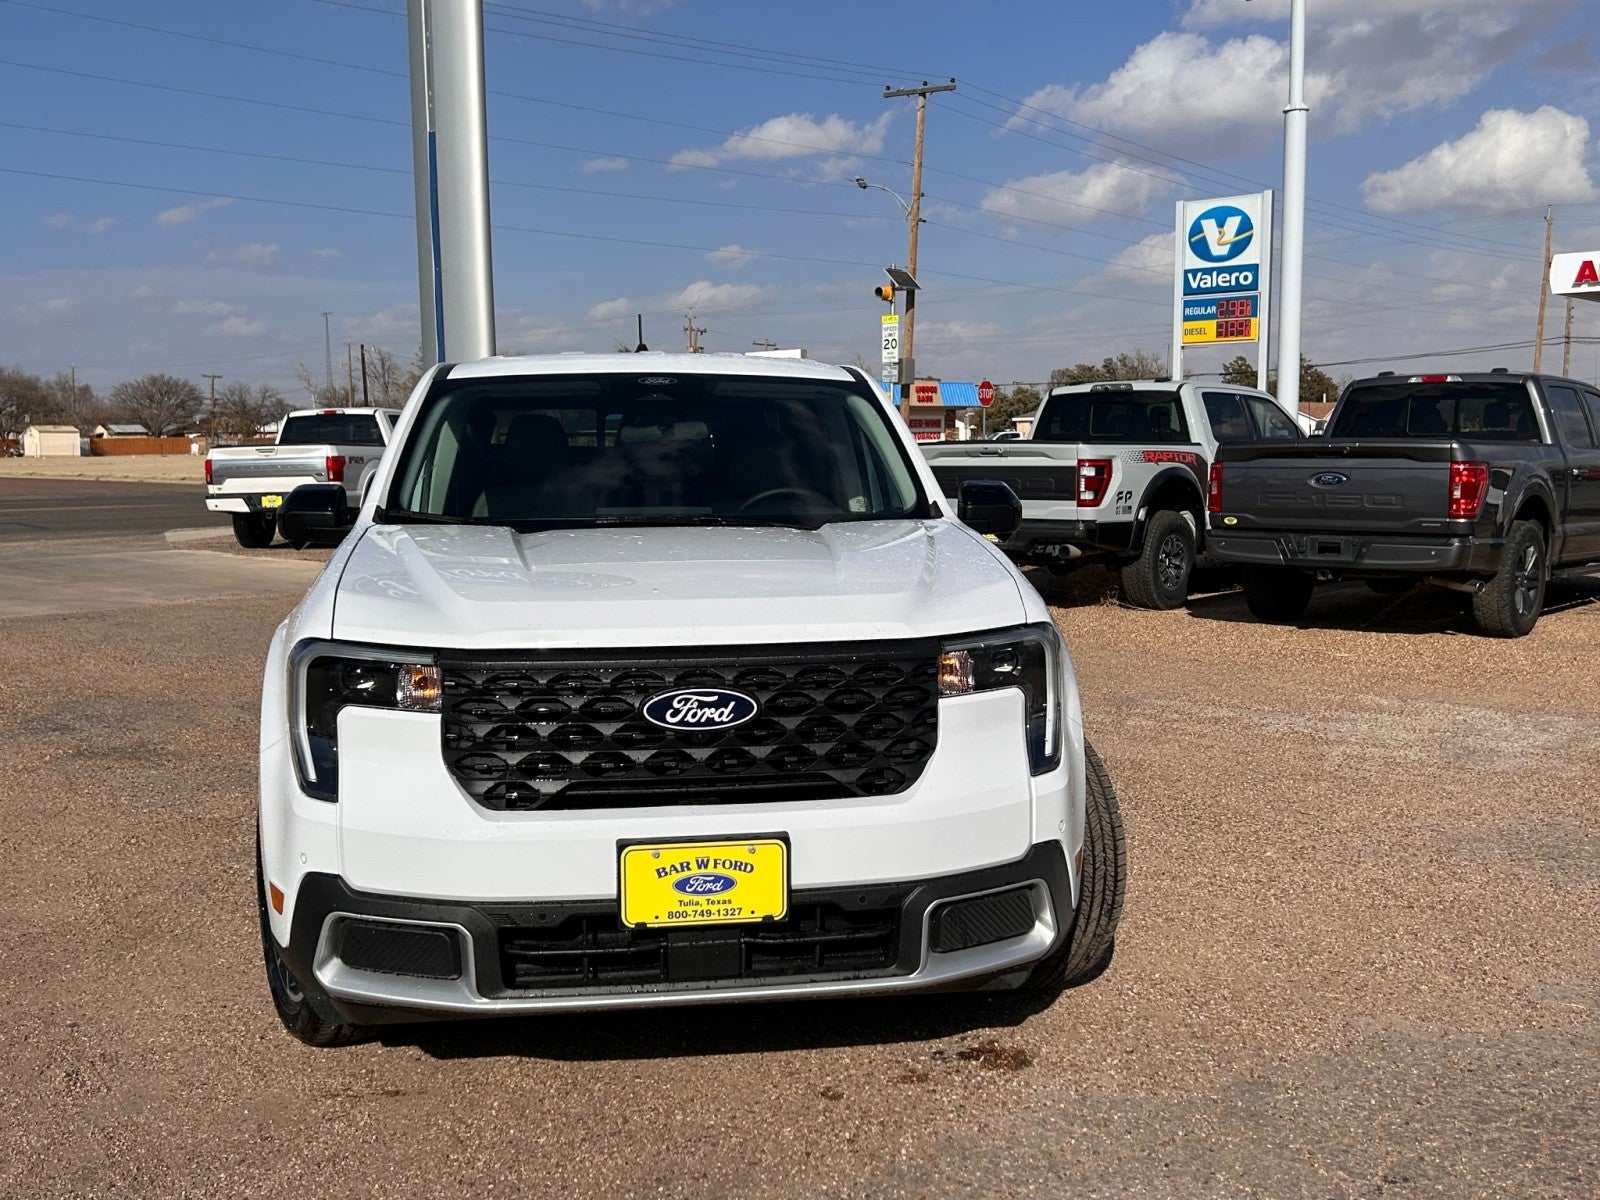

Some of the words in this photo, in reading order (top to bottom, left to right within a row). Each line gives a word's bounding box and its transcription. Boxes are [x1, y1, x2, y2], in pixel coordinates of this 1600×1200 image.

[1187, 271, 1253, 289] Valero
[1184, 306, 1217, 316] REGULAR
[1184, 326, 1208, 336] DIESEL
[883, 338, 898, 350] 20
[979, 388, 993, 399] STOP
[913, 432, 941, 440] TOBACCO
[1143, 450, 1197, 465] RAPTOR
[1257, 491, 1405, 509] F-150
[665, 694, 736, 724] Ford
[655, 860, 692, 879] BAR
[695, 856, 710, 870] W
[713, 858, 755, 874] FORD
[685, 875, 724, 892] Ford
[678, 899, 703, 908] Tulia,
[705, 898, 732, 906] Texas
[667, 907, 743, 920] 800-749-1327
